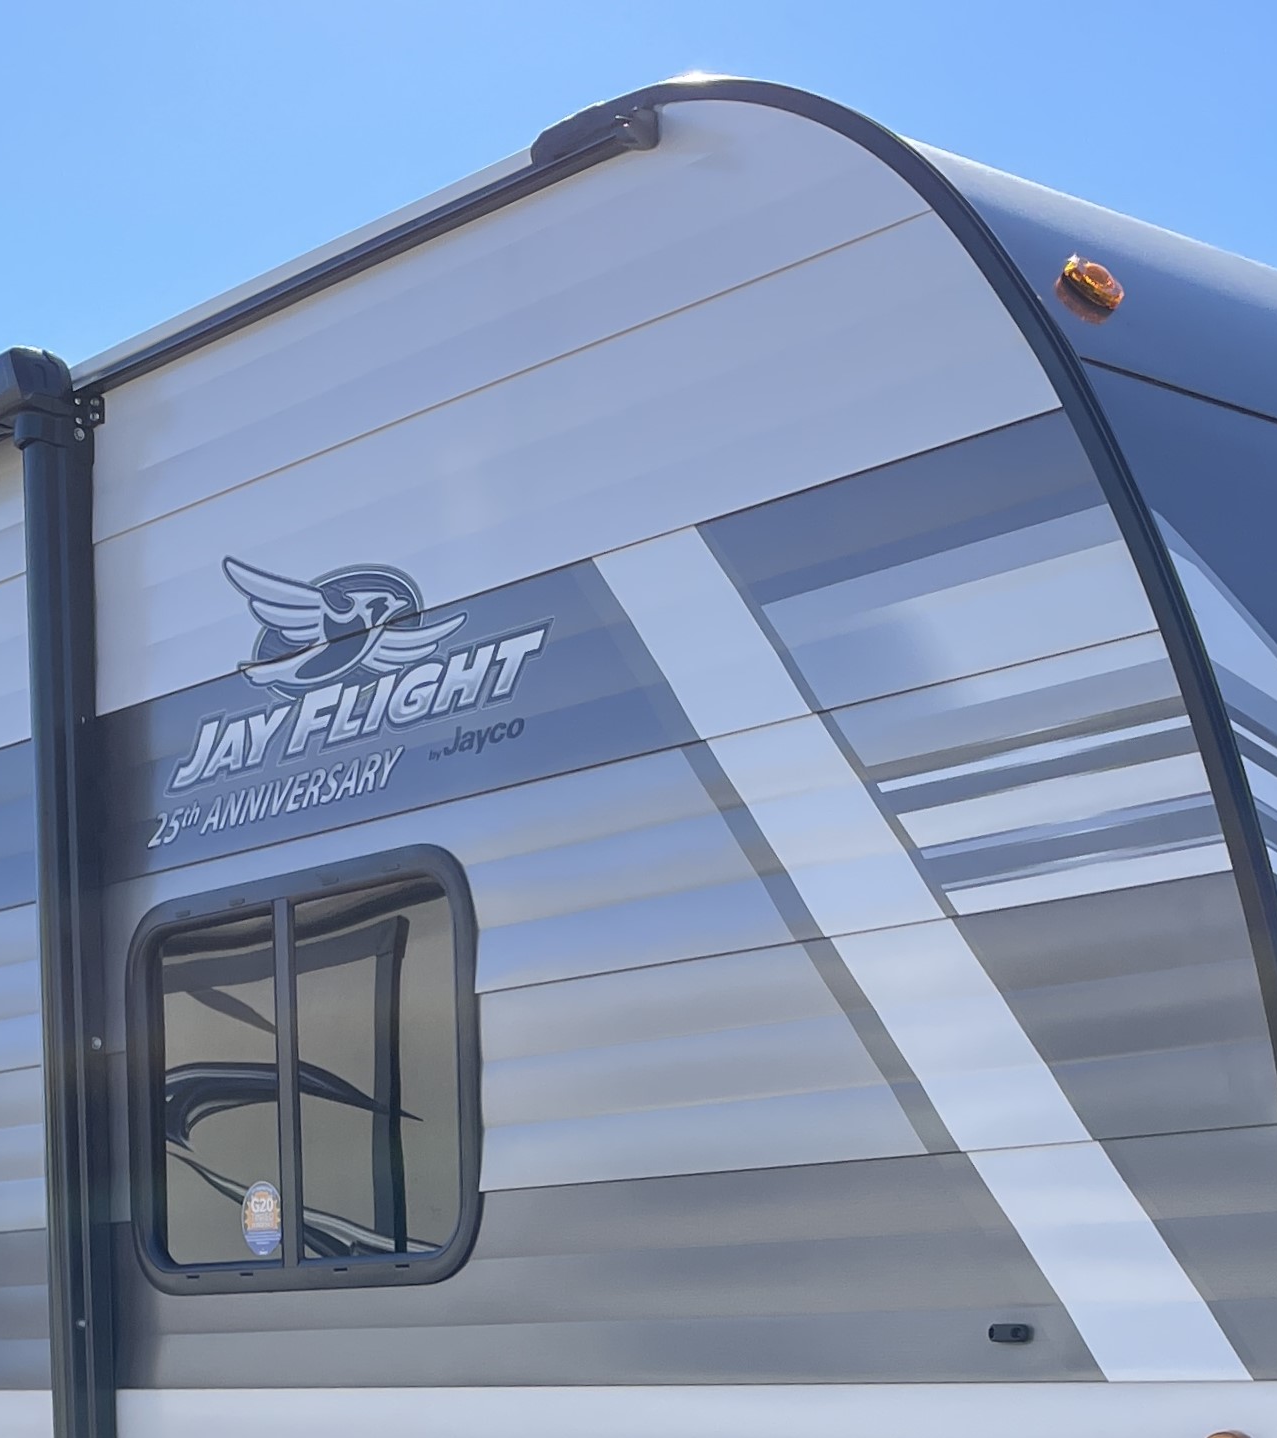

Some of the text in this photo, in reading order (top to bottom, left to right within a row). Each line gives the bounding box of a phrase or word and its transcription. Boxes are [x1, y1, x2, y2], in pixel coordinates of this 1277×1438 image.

[172, 629, 545, 788] JAY FLIGHT
[428, 717, 525, 761] by Jayco
[147, 745, 404, 849] 25th ANNIVERSARY
[251, 1198, 274, 1213] G20
